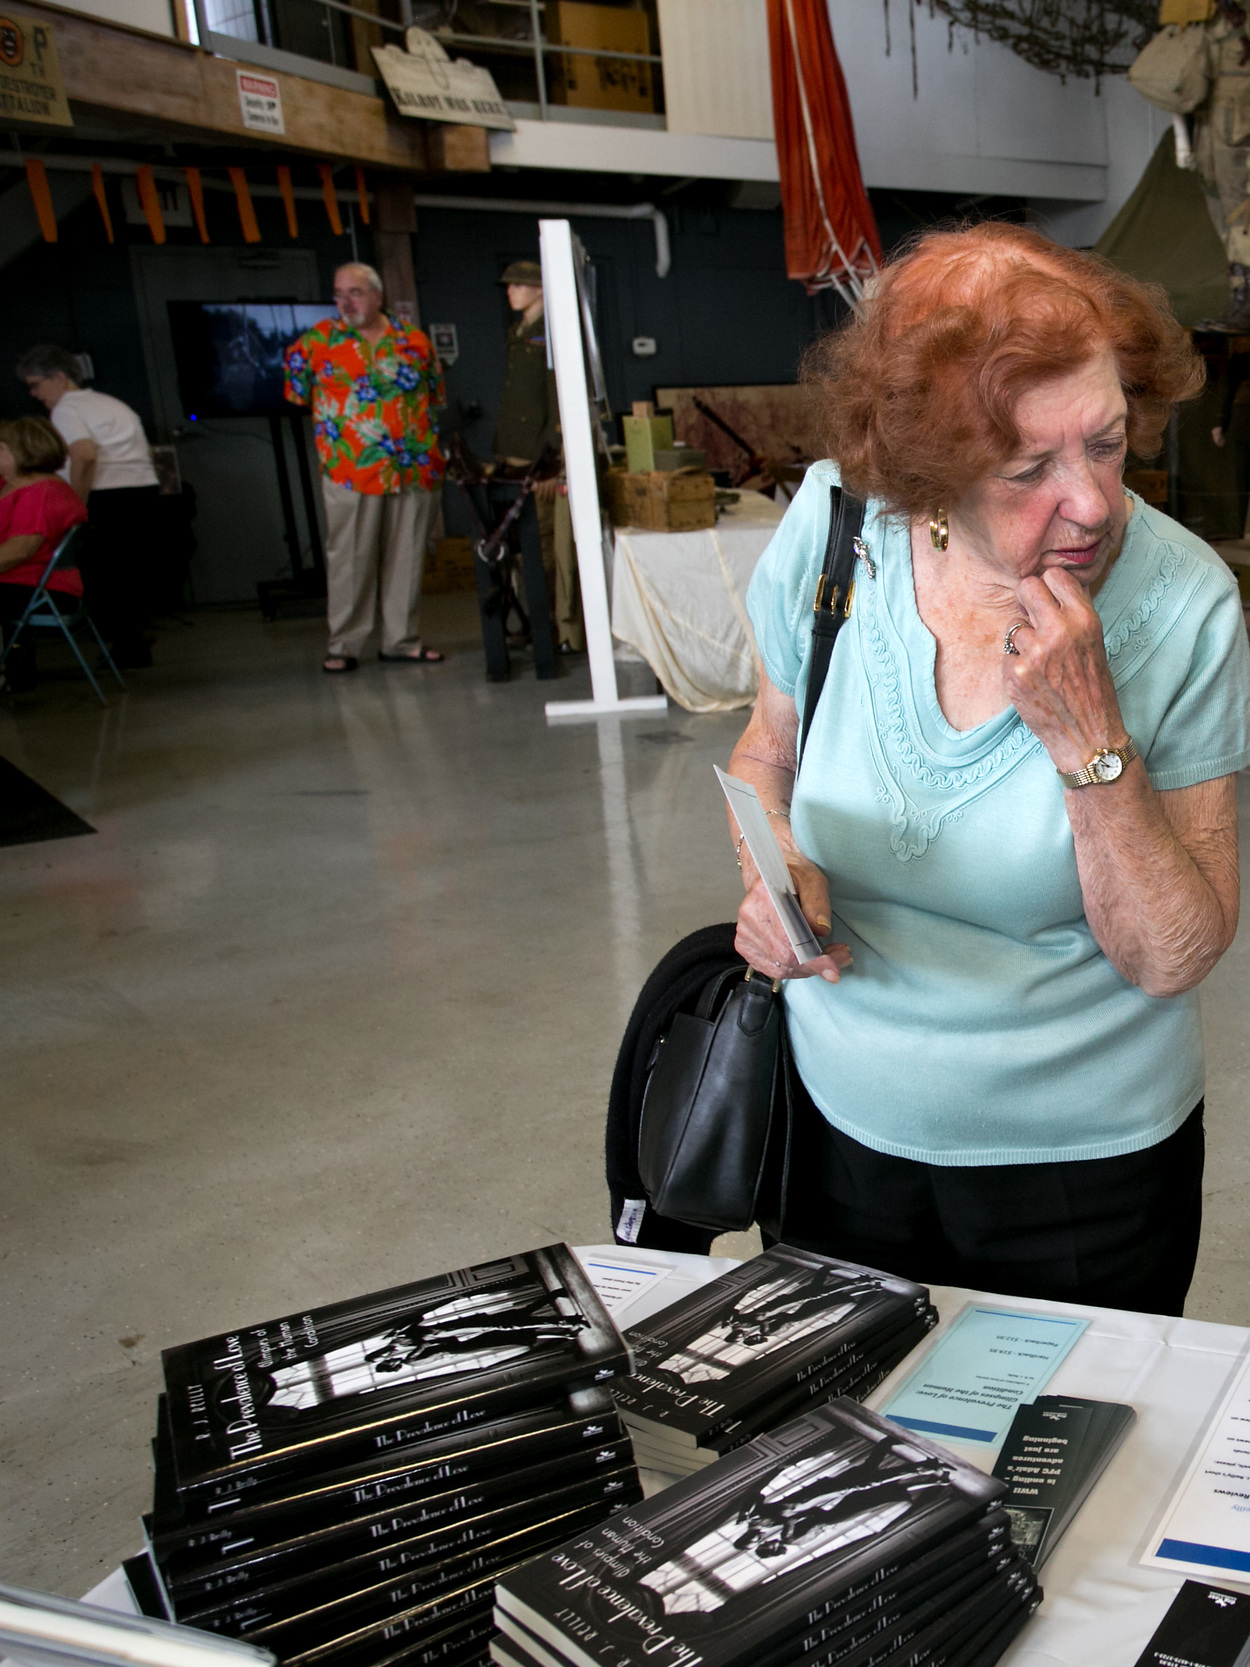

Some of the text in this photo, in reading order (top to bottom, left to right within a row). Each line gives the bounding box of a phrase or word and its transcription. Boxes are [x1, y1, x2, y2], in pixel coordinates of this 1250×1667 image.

[301, 1315, 319, 1348] Condition
[1025, 1338, 1059, 1347] Paperback
[213, 1335, 243, 1364] Love
[257, 1337, 277, 1368] Glimpses
[1018, 1352, 1050, 1360] Hardback
[923, 1383, 954, 1393] Human
[949, 1395, 995, 1408] Prevalence
[979, 1391, 1018, 1403] Glimpses
[983, 1385, 1023, 1395] Condition
[220, 1371, 258, 1436] Prevalence
[698, 1398, 725, 1418] The
[374, 1407, 486, 1448] The Prevalence of Love
[1022, 1435, 1068, 1445] beginning
[229, 1429, 263, 1460] The
[1007, 1466, 1040, 1474] Adair's
[1012, 1456, 1064, 1464] adventures
[353, 1462, 469, 1503] The Prevalence of Love
[1012, 1475, 1044, 1484] ending
[1013, 1487, 1038, 1495] WWII
[1213, 1488, 1250, 1500] Reviews
[370, 1495, 484, 1538] The Prevalence of Love
[601, 1527, 652, 1565] the Human
[622, 1516, 665, 1549] Condition
[379, 1528, 493, 1572] The Prevalence of Love
[574, 1539, 630, 1578] Glimpses of
[551, 1553, 586, 1585] Love
[565, 1575, 601, 1590] of
[384, 1586, 495, 1640] The Prevalence of Love
[553, 1608, 598, 1641] REILLY
[598, 1585, 675, 1655] Prevalence
